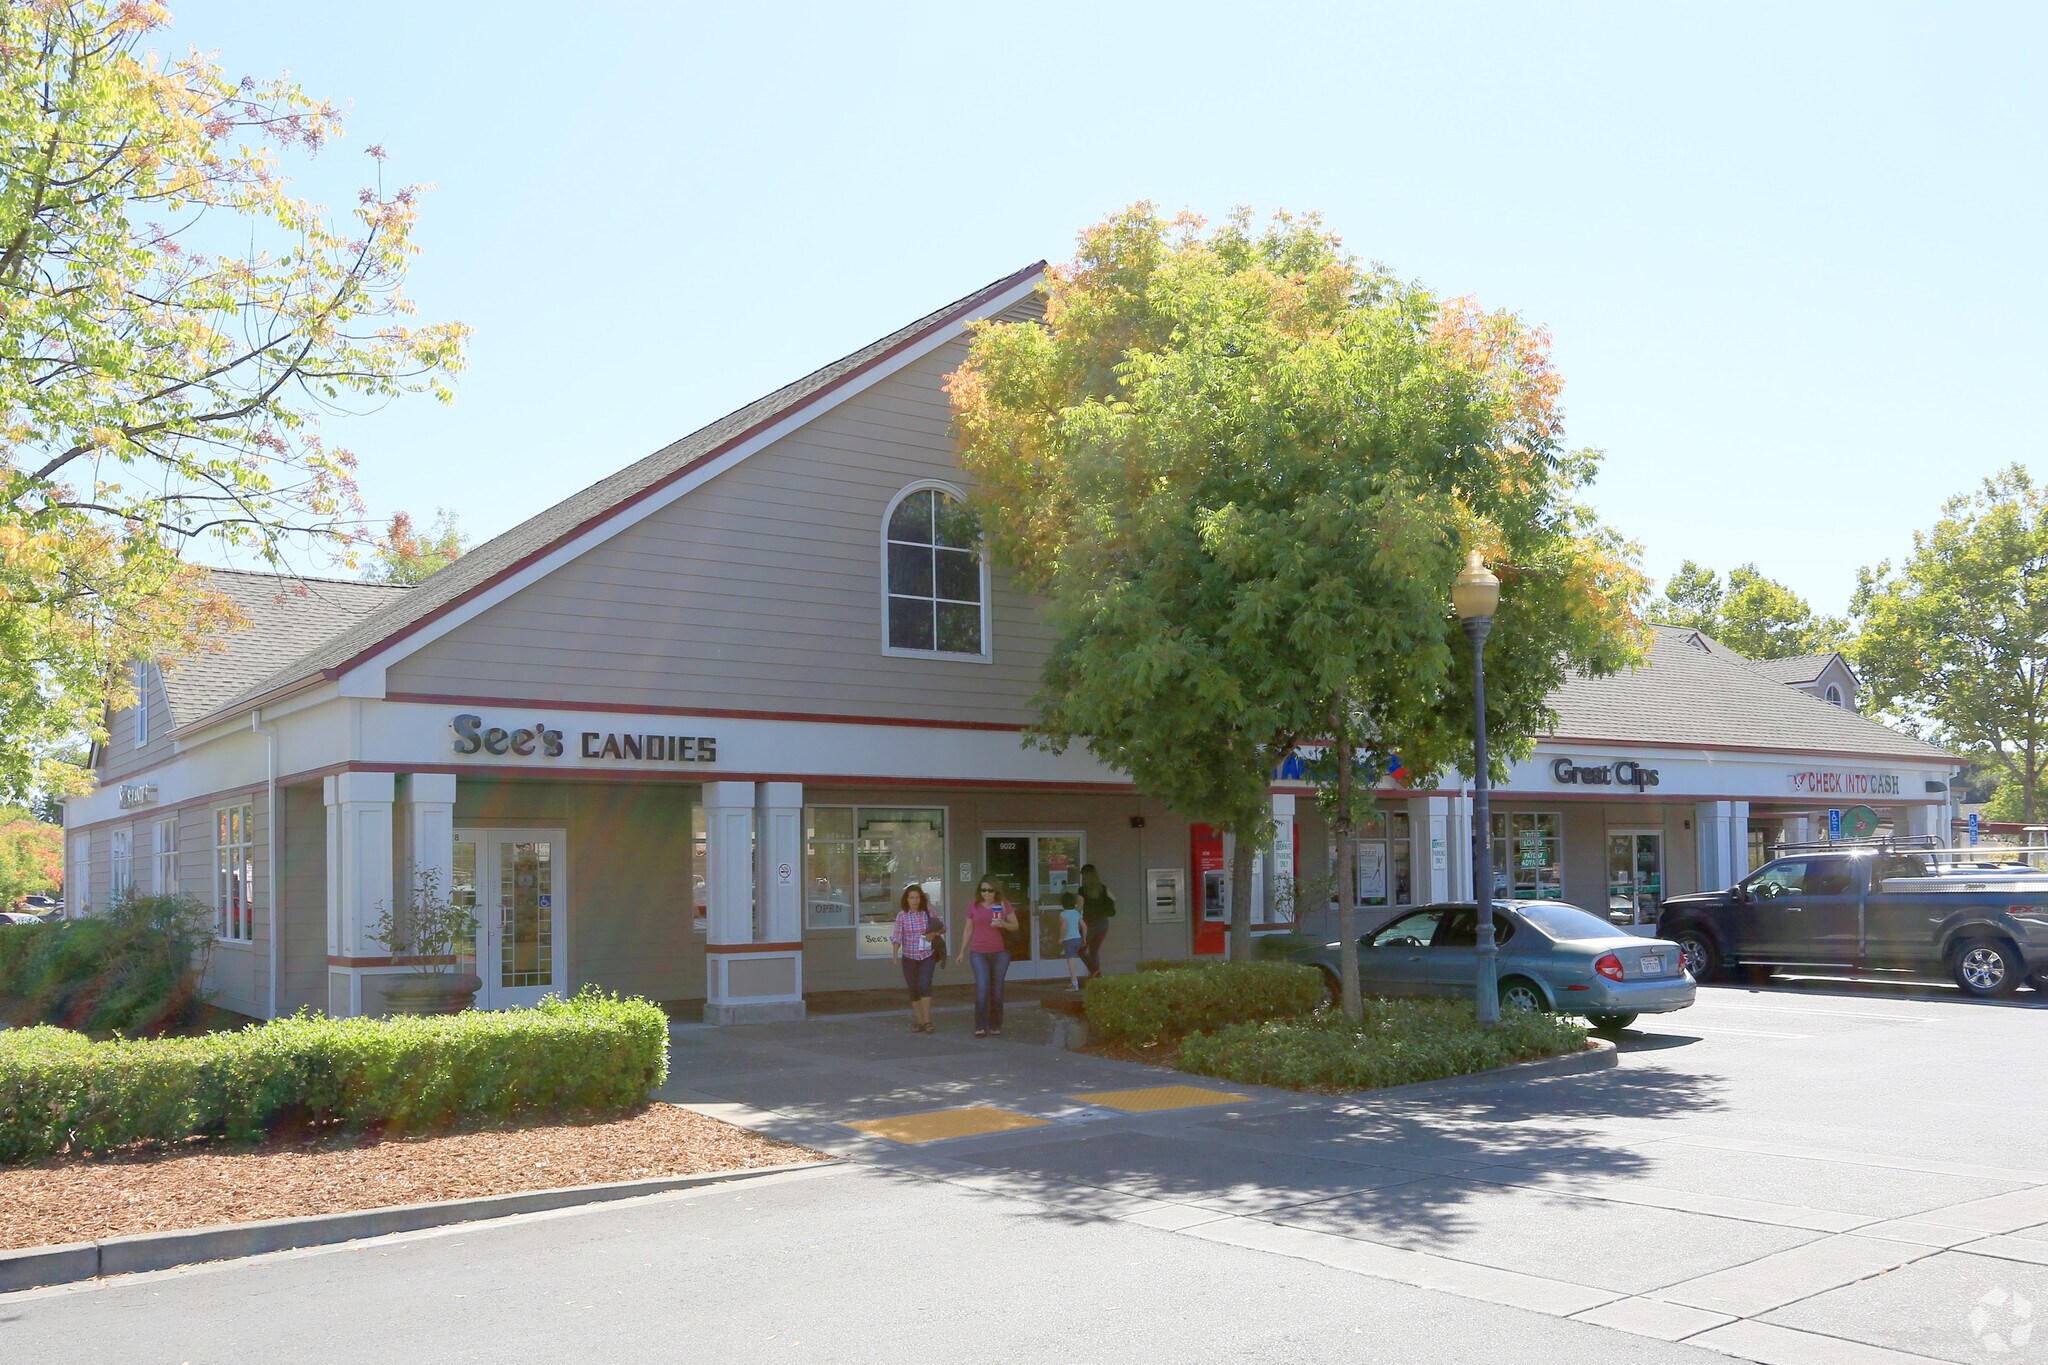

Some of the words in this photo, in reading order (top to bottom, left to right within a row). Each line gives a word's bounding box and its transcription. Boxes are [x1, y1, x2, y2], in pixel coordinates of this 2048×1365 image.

[452, 713, 564, 758] See's
[580, 732, 717, 763] CANDIES
[1552, 758, 1611, 785] Great
[1613, 761, 1660, 792] Clips
[1808, 771, 1842, 793] CHECK
[1845, 774, 1868, 794] INTO
[1870, 774, 1900, 795] CASH
[999, 842, 1017, 850] 9022
[1523, 839, 1543, 847] LOAS
[815, 904, 842, 914] OPEN
[864, 935, 888, 943] See's
